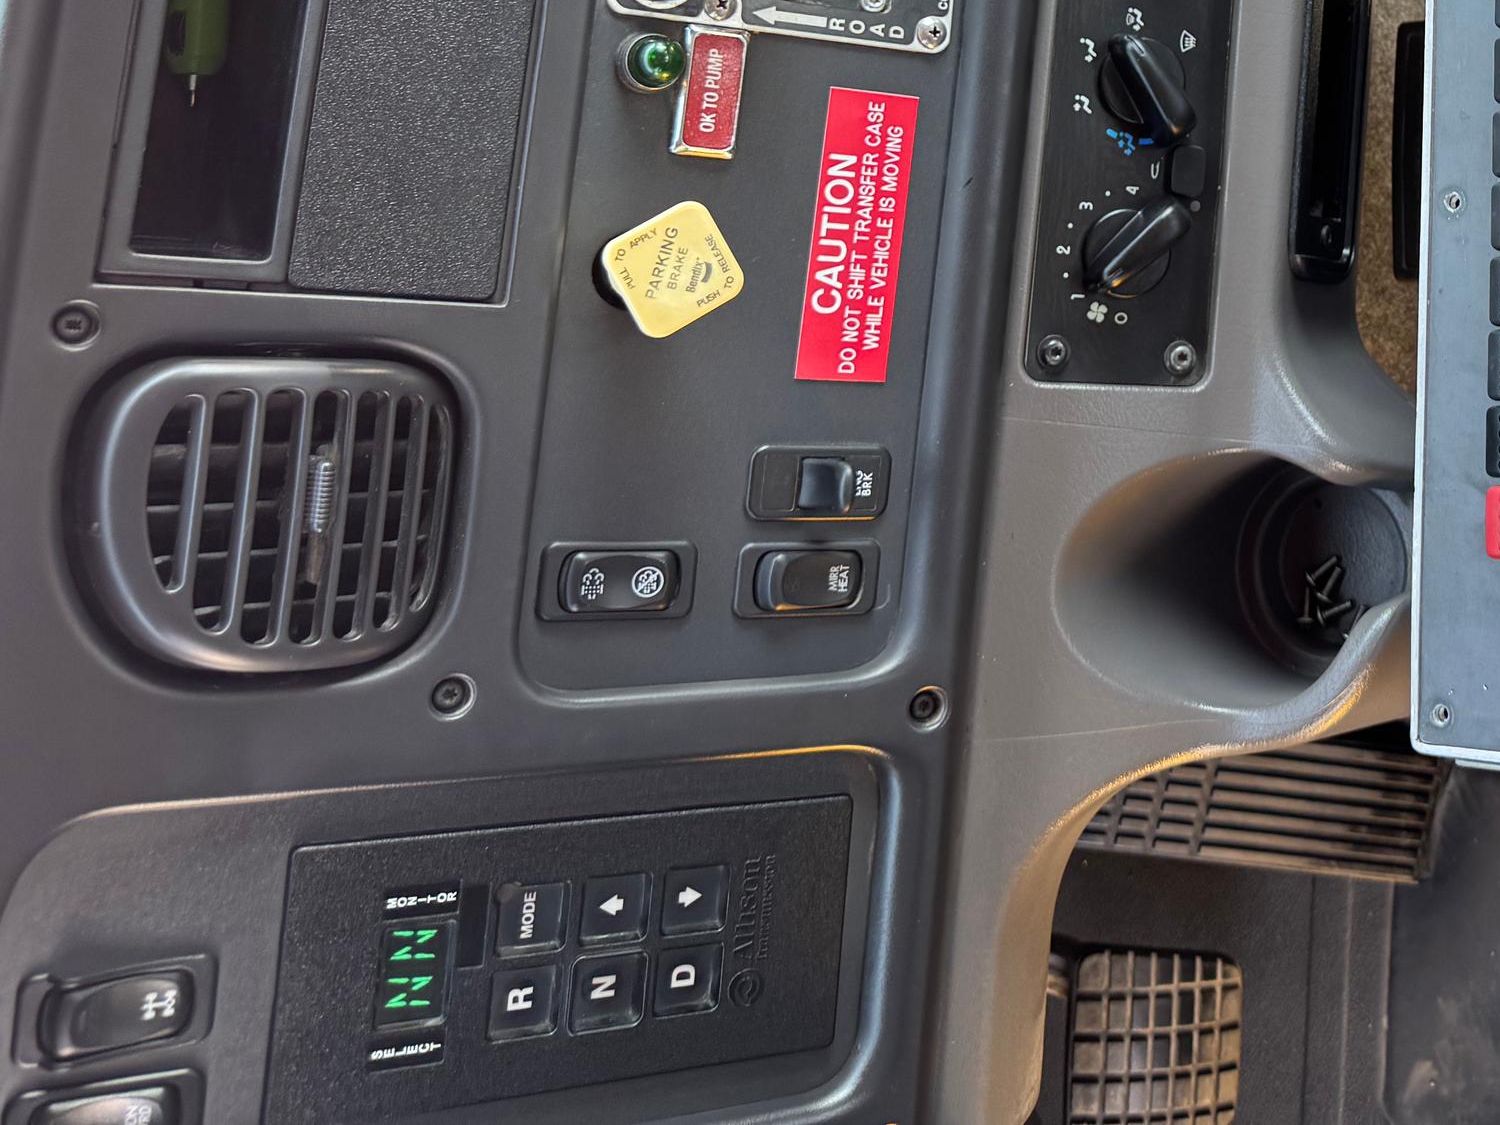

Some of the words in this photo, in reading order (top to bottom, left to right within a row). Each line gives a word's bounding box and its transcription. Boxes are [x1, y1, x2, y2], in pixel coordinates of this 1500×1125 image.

[828, 17, 905, 39] ROAD
[704, 48, 724, 89] PUMP
[702, 91, 720, 110] TO
[698, 113, 717, 133] OK
[864, 100, 886, 148] CASE
[883, 125, 905, 192] MOVING
[853, 153, 880, 244] TRANSFER
[879, 196, 896, 214] IS
[629, 227, 658, 249] APPLY
[810, 152, 858, 315] CAUTION
[615, 248, 626, 262] TO
[644, 226, 679, 300] PARKING
[704, 234, 731, 273] RELEASE
[869, 217, 894, 291] VEHICLE
[619, 267, 637, 290] PULL
[667, 247, 689, 291] BRAKE
[848, 254, 868, 299] SHIFT
[723, 276, 735, 290] TO
[696, 289, 721, 307] PUSH
[842, 308, 861, 343] NOT
[861, 295, 886, 351] WHILE
[838, 348, 857, 375] DO
[861, 472, 873, 497] BRK
[828, 565, 839, 592] MIRR
[838, 564, 850, 593] HEAT
[385, 890, 458, 910] MONITOR
[519, 890, 537, 939] MODE
[590, 973, 617, 1000] N
[670, 963, 696, 989] D
[506, 985, 534, 1012] R
[369, 1042, 442, 1061] SELECT
